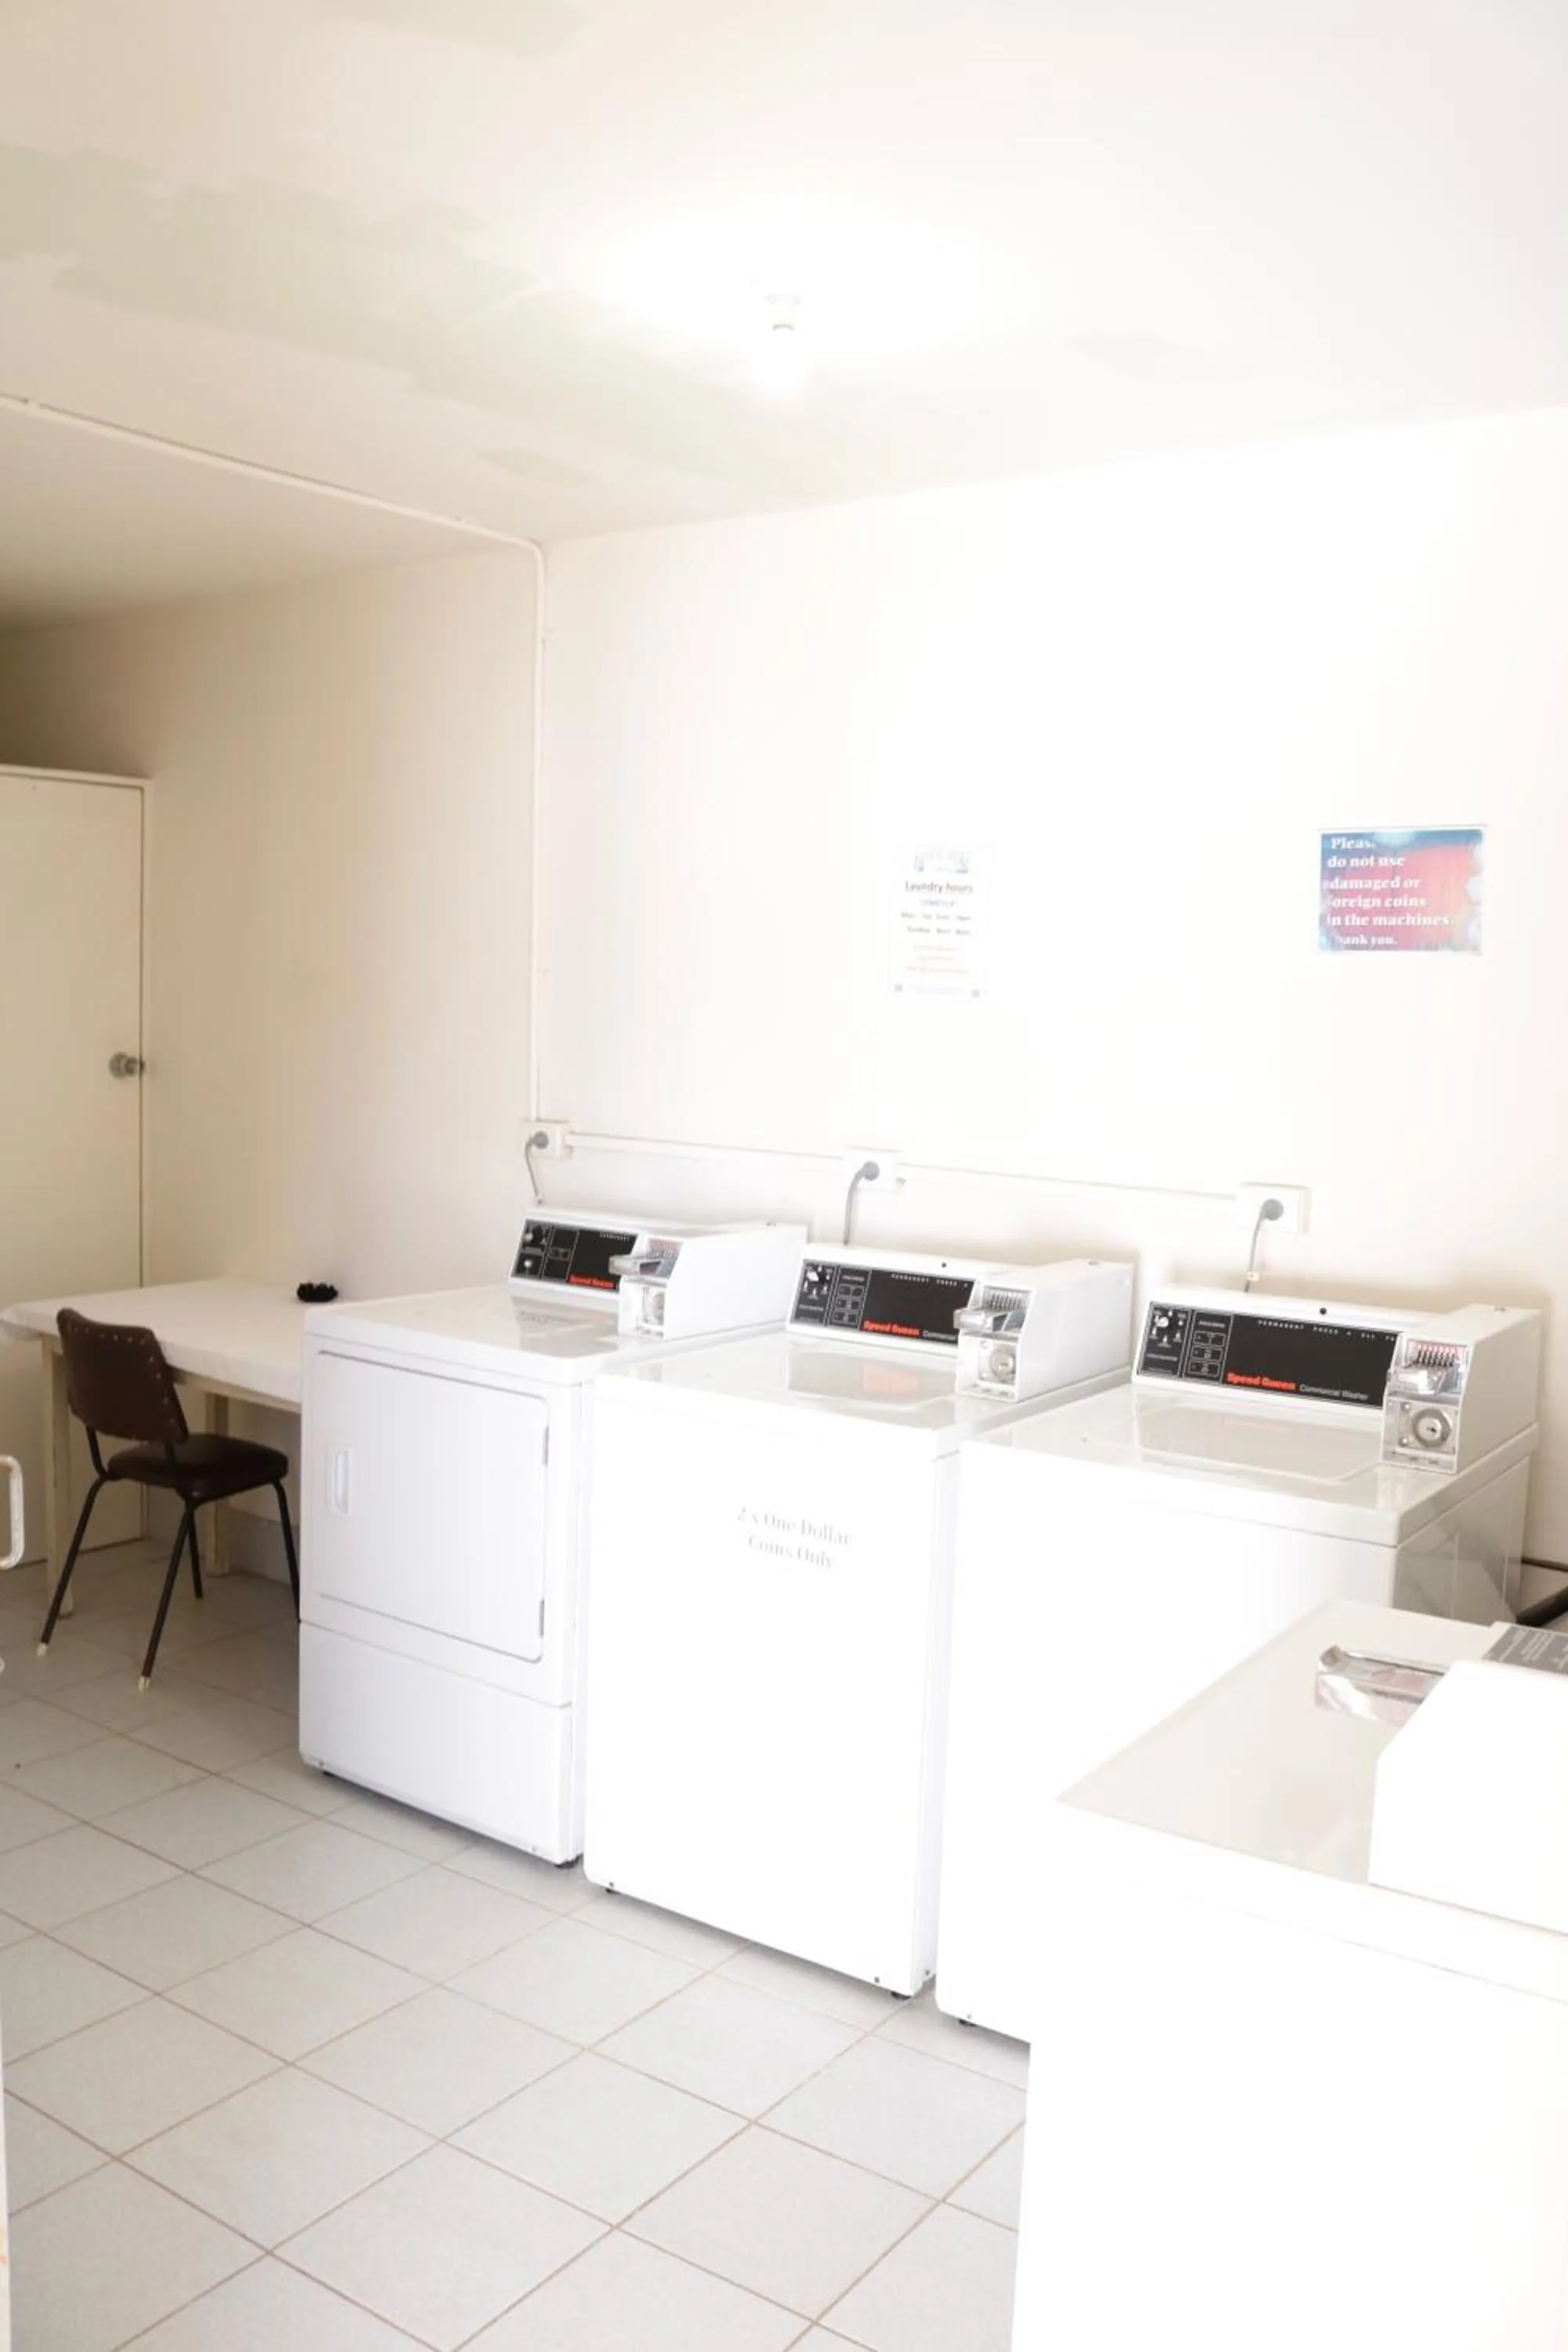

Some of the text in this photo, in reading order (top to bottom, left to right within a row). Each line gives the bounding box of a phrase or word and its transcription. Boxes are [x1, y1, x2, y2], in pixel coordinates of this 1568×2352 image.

[1327, 855, 1406, 868] do not use
[905, 880, 973, 894] Laundry hours
[1330, 876, 1421, 891] damaged or
[1385, 895, 1426, 907] coins
[1345, 914, 1370, 926] the
[1227, 1372, 1261, 1385] Speed
[1261, 1377, 1296, 1390] Queen
[763, 1512, 797, 1531] One
[800, 1517, 855, 1545] Dollar
[749, 1534, 837, 1570] Coins Only
